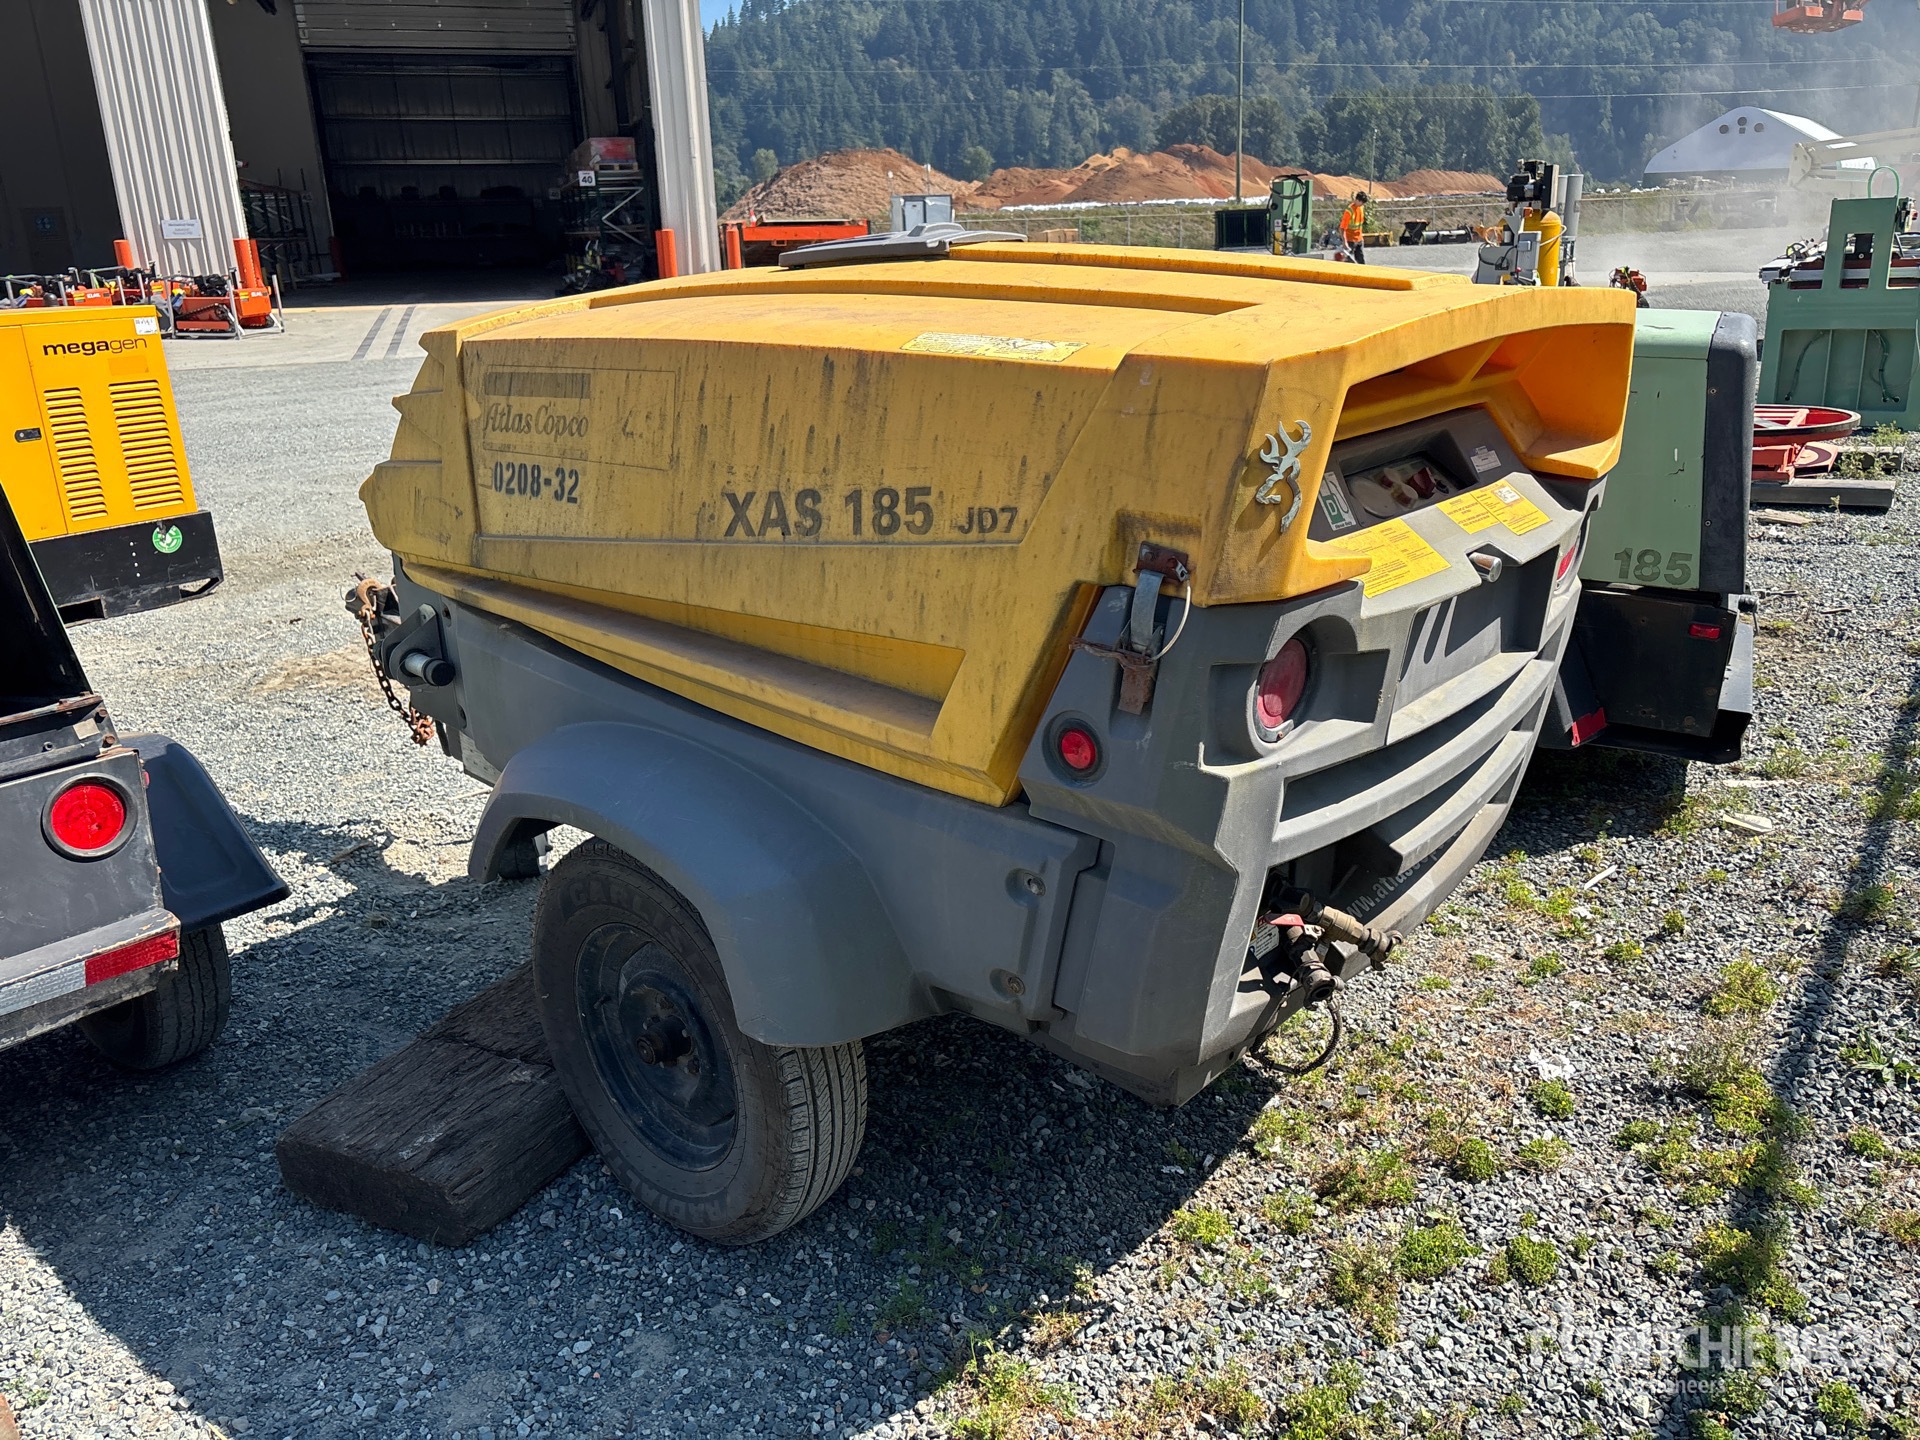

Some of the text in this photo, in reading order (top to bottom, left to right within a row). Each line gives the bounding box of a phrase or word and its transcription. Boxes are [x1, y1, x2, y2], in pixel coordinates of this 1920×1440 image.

[581, 175, 593, 184] 40
[43, 338, 147, 356] megagen
[483, 402, 589, 442] Atlas Copco
[493, 461, 580, 504] 0208-32
[724, 486, 1018, 538] XAS 185 JD7
[1613, 547, 1693, 586] 185
